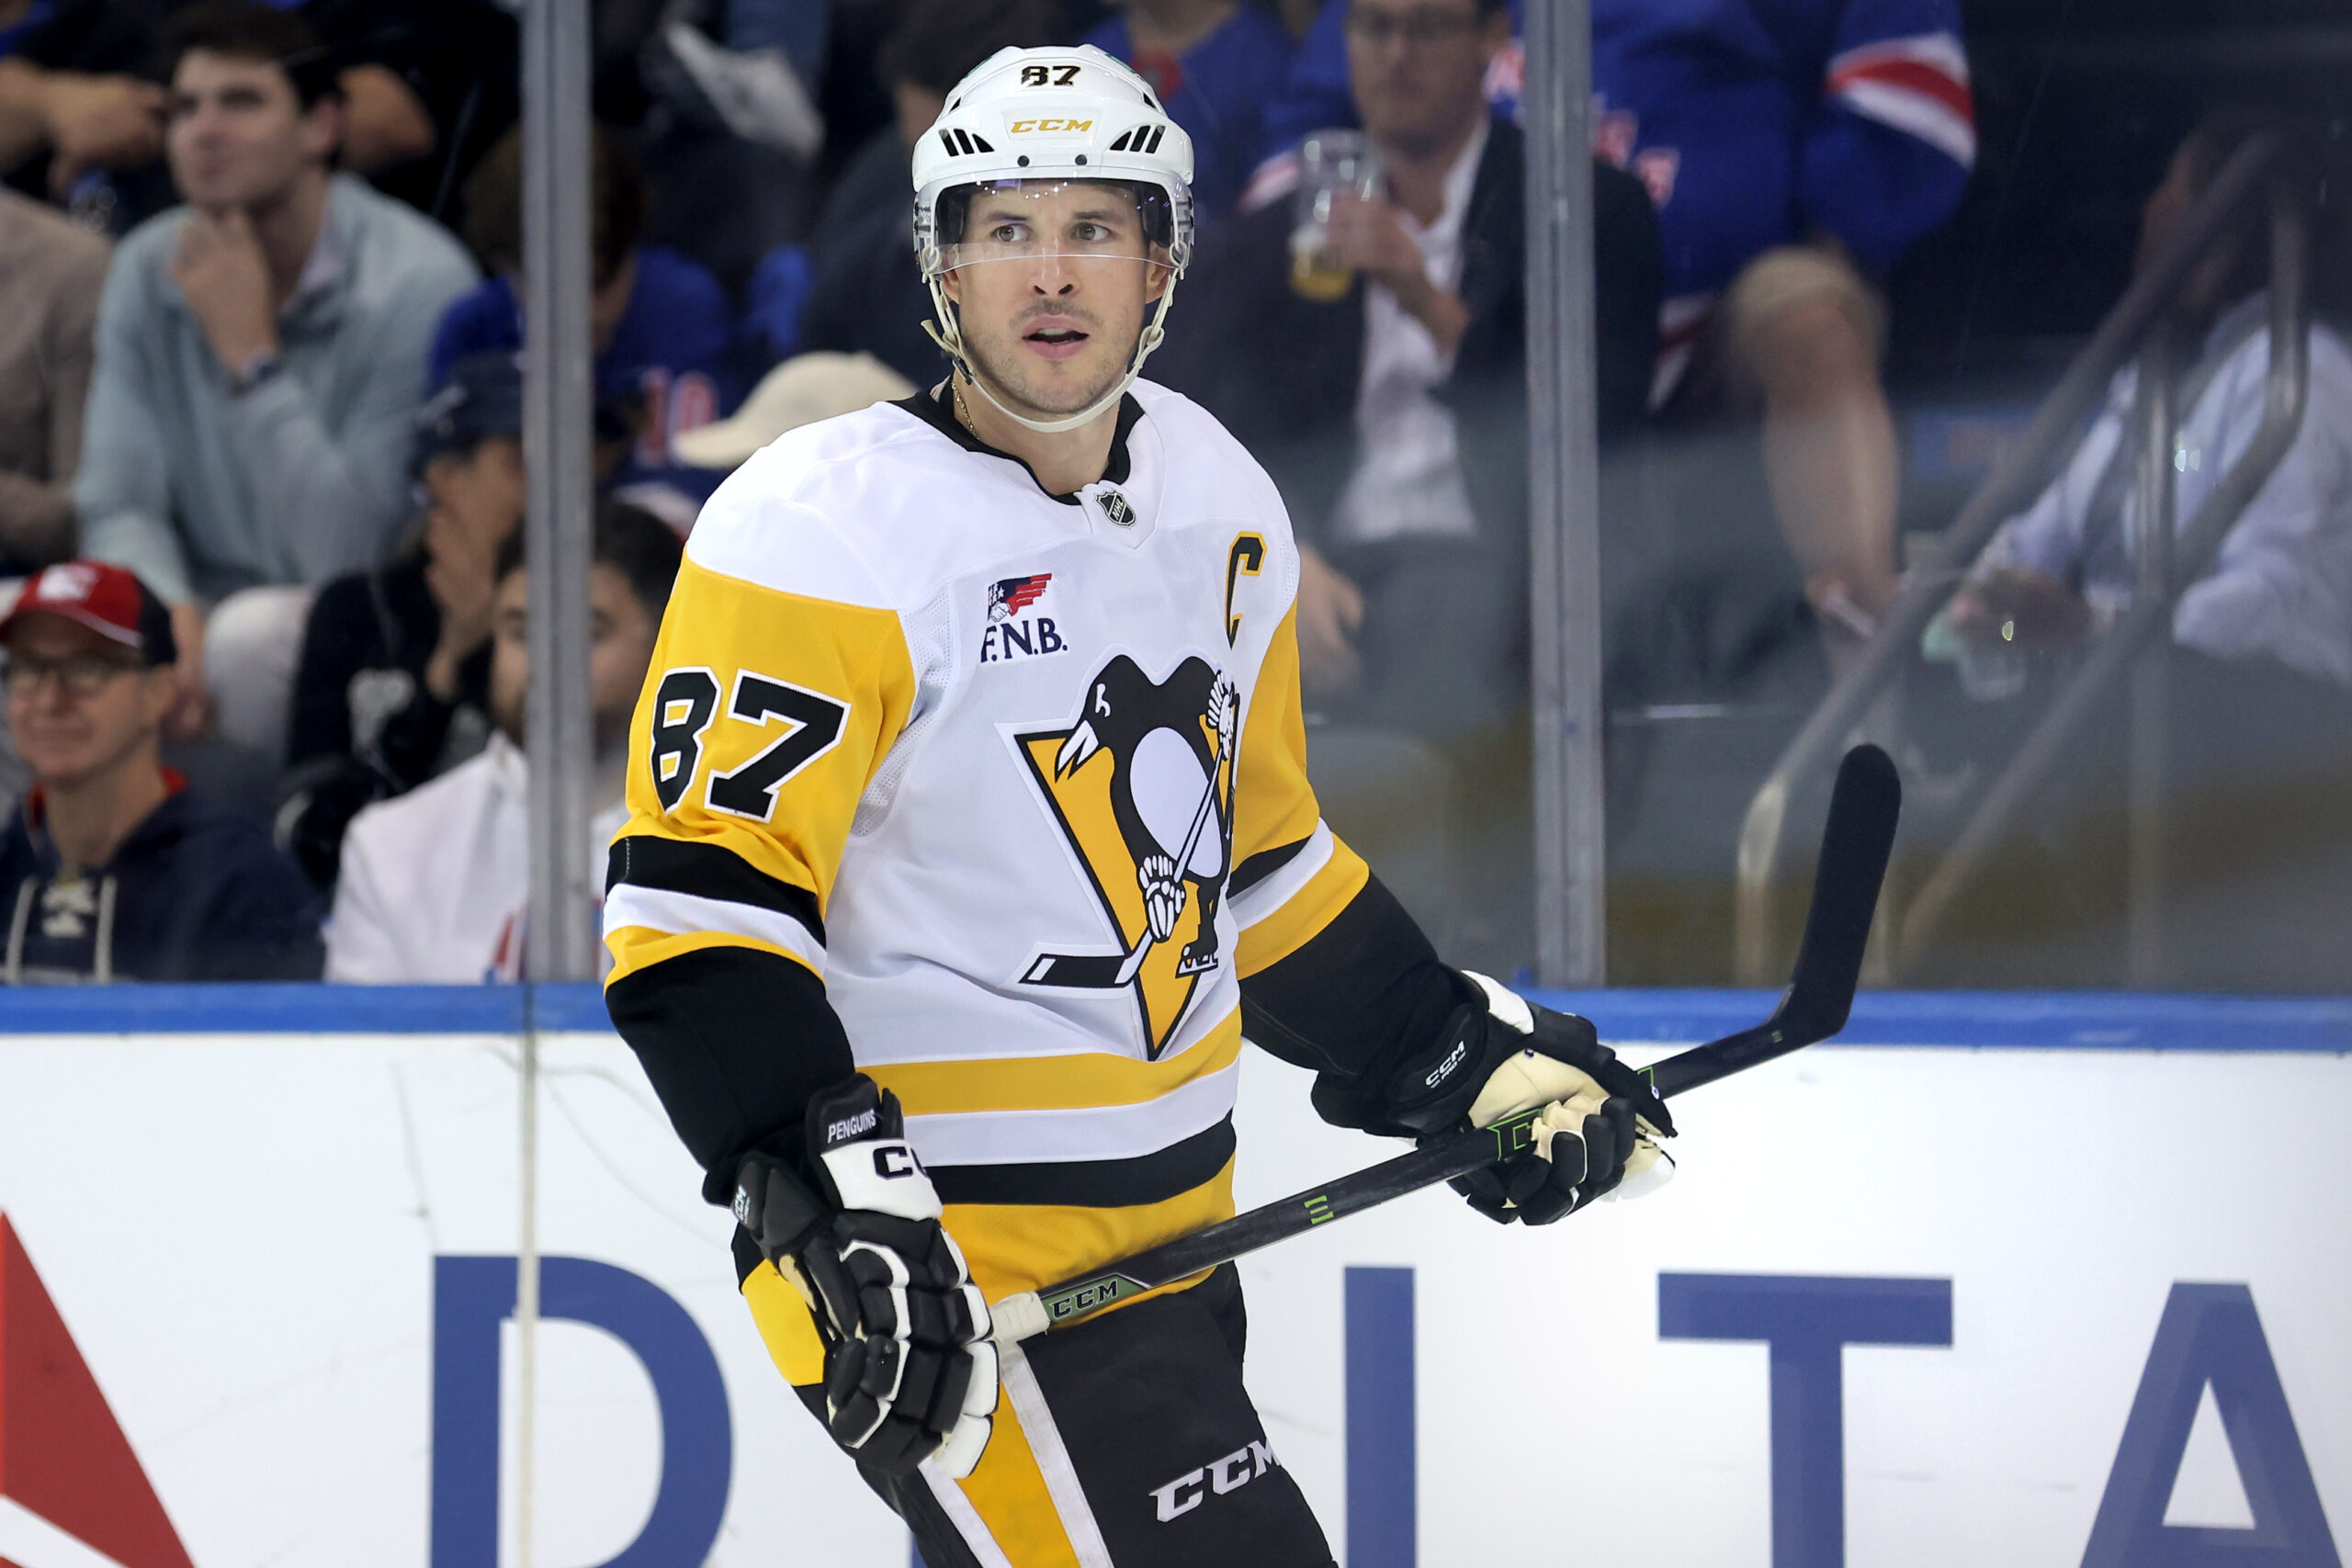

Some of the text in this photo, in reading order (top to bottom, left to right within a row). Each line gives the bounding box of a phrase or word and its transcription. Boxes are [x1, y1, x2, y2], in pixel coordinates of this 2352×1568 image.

[1021, 65, 1081, 86] 87
[1011, 118, 1092, 133] CCM
[1112, 498, 1124, 521] NHL
[650, 666, 852, 823] 87
[1425, 1040, 1465, 1086] CCM
[827, 1108, 876, 1144] PENGUINS
[1050, 1279, 1118, 1319] CCM
[1148, 1438, 1282, 1523] CCM
